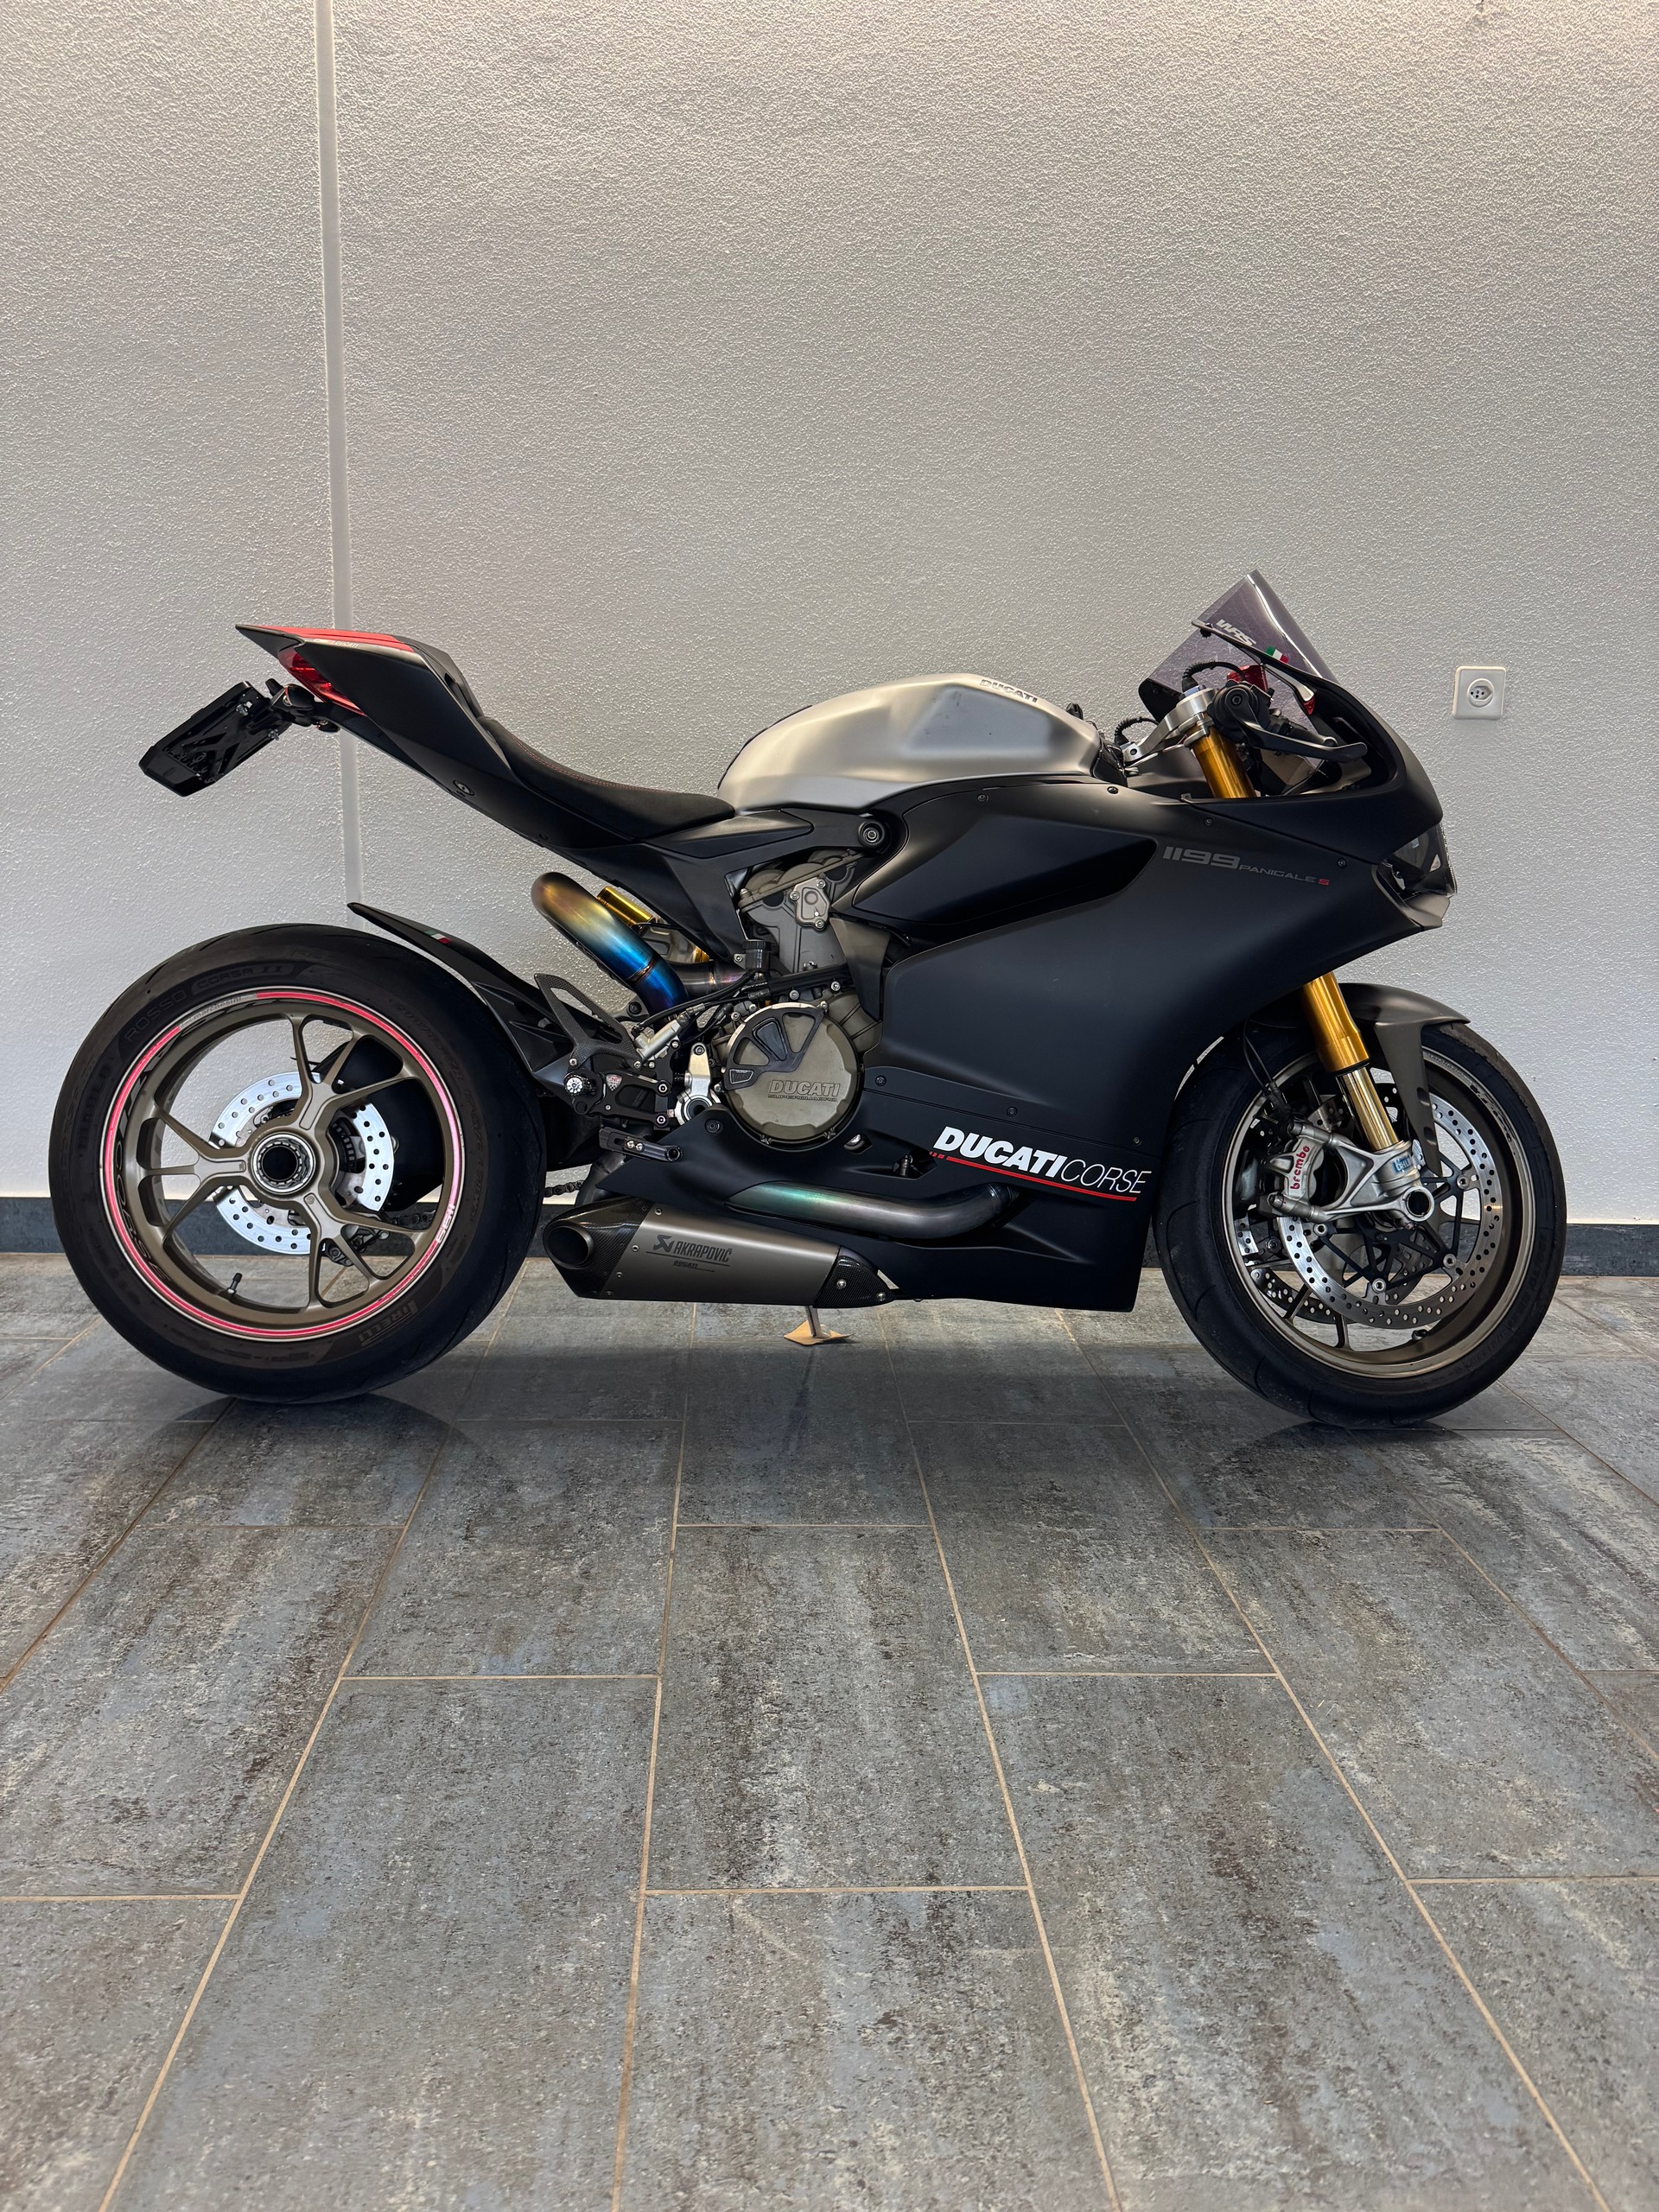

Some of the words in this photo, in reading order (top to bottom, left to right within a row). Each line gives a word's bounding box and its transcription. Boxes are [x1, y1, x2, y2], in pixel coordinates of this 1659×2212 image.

[1216, 619, 1256, 646] WRS
[980, 679, 1038, 702] DUCATI
[1162, 846, 1241, 869] 1199
[1238, 864, 1317, 883] PANIGALE
[123, 988, 188, 1042] ROSSO
[197, 968, 255, 989] CORSA
[768, 1079, 841, 1096] DUCATI
[933, 1126, 1068, 1178] DUCATI
[1060, 1159, 1152, 1194] CORSE
[1290, 1146, 1310, 1189] brembo
